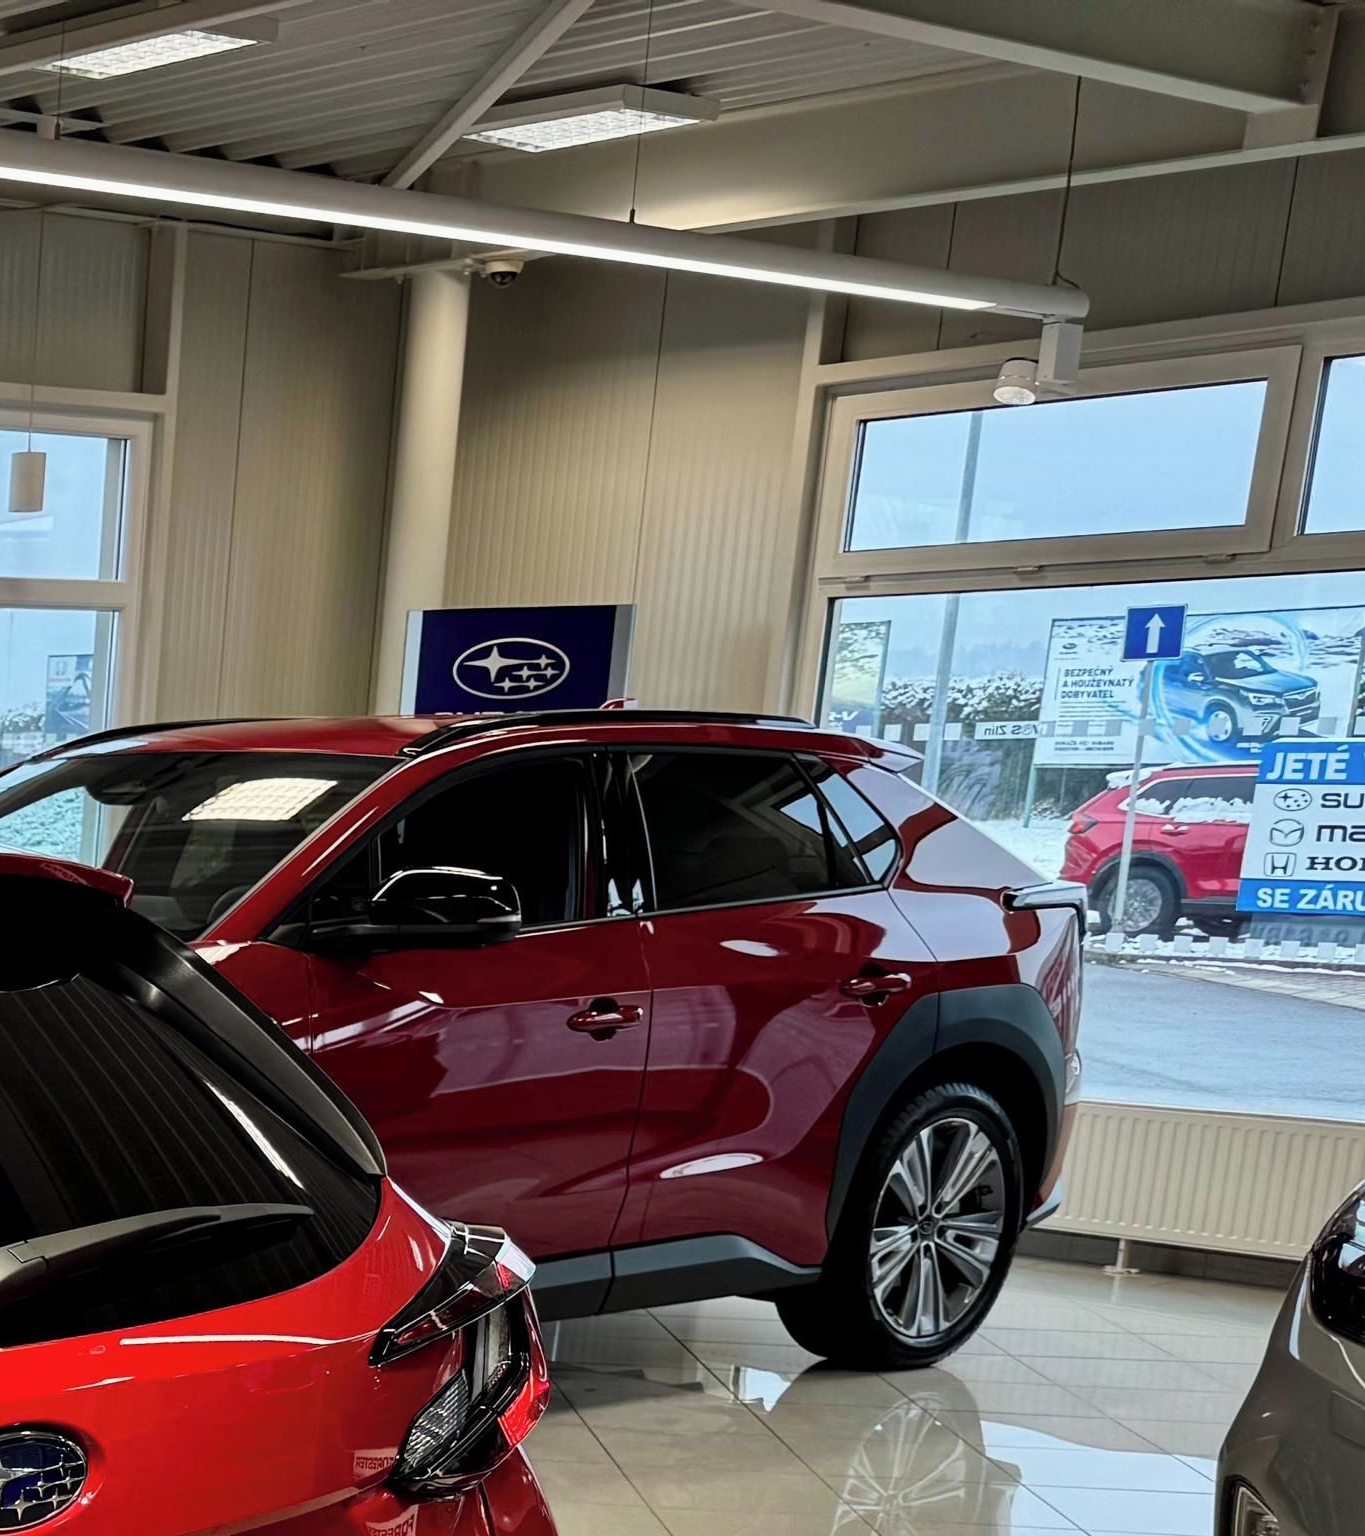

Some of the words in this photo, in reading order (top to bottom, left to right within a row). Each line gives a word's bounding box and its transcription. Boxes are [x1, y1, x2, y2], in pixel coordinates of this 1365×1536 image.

[1062, 679, 1069, 688] A
[1060, 689, 1115, 699] DOBYVATEL
[1265, 744, 1350, 781] JETÉ
[1256, 887, 1292, 909] SE
